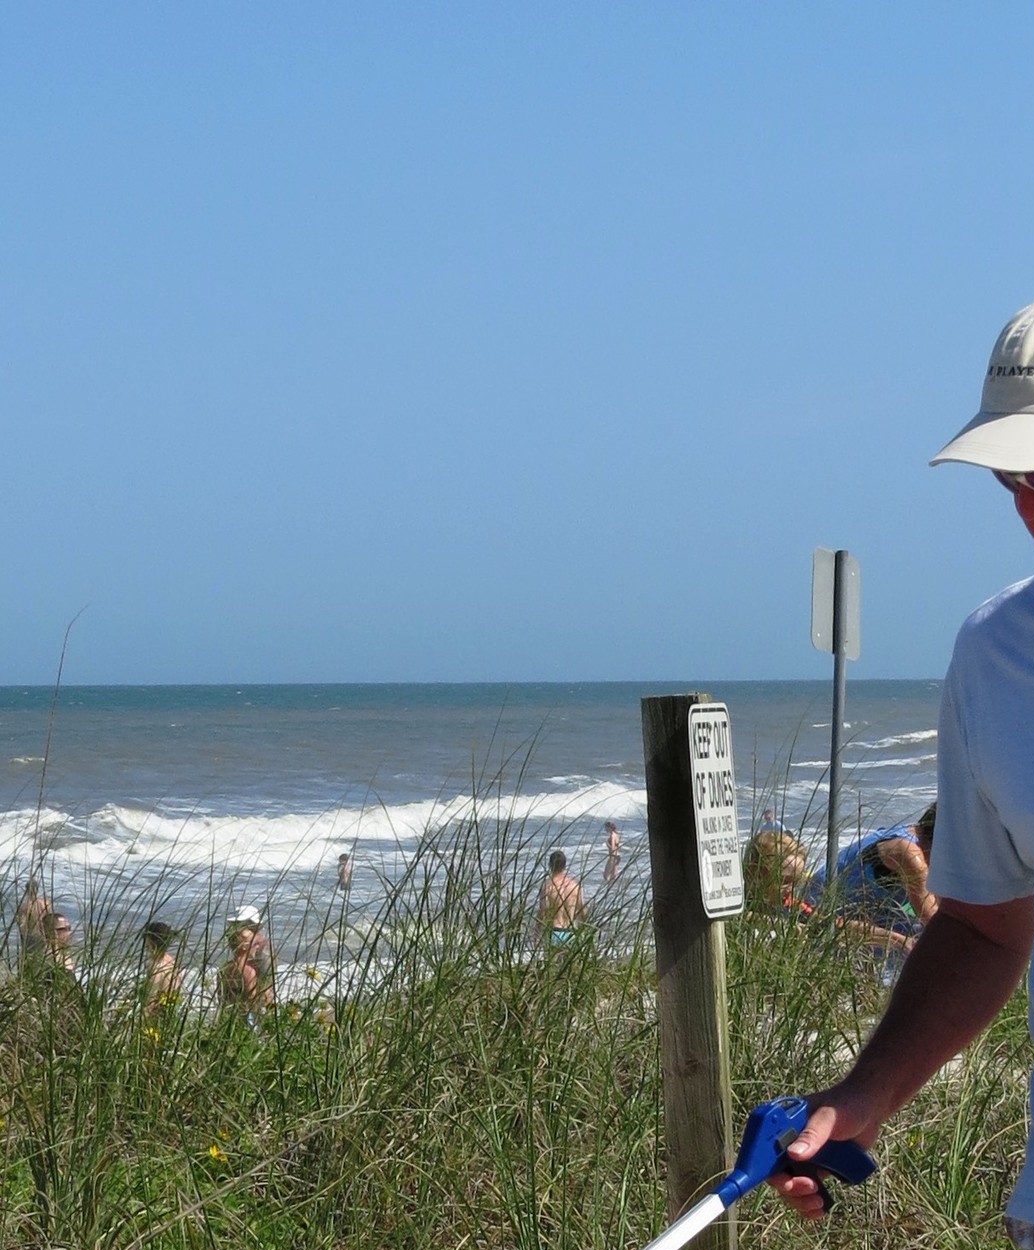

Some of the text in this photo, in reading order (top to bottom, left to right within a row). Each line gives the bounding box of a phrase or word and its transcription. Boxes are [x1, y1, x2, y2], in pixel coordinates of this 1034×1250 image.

[692, 720, 728, 759] KEEP OUT
[695, 770, 733, 810] OF DUNES
